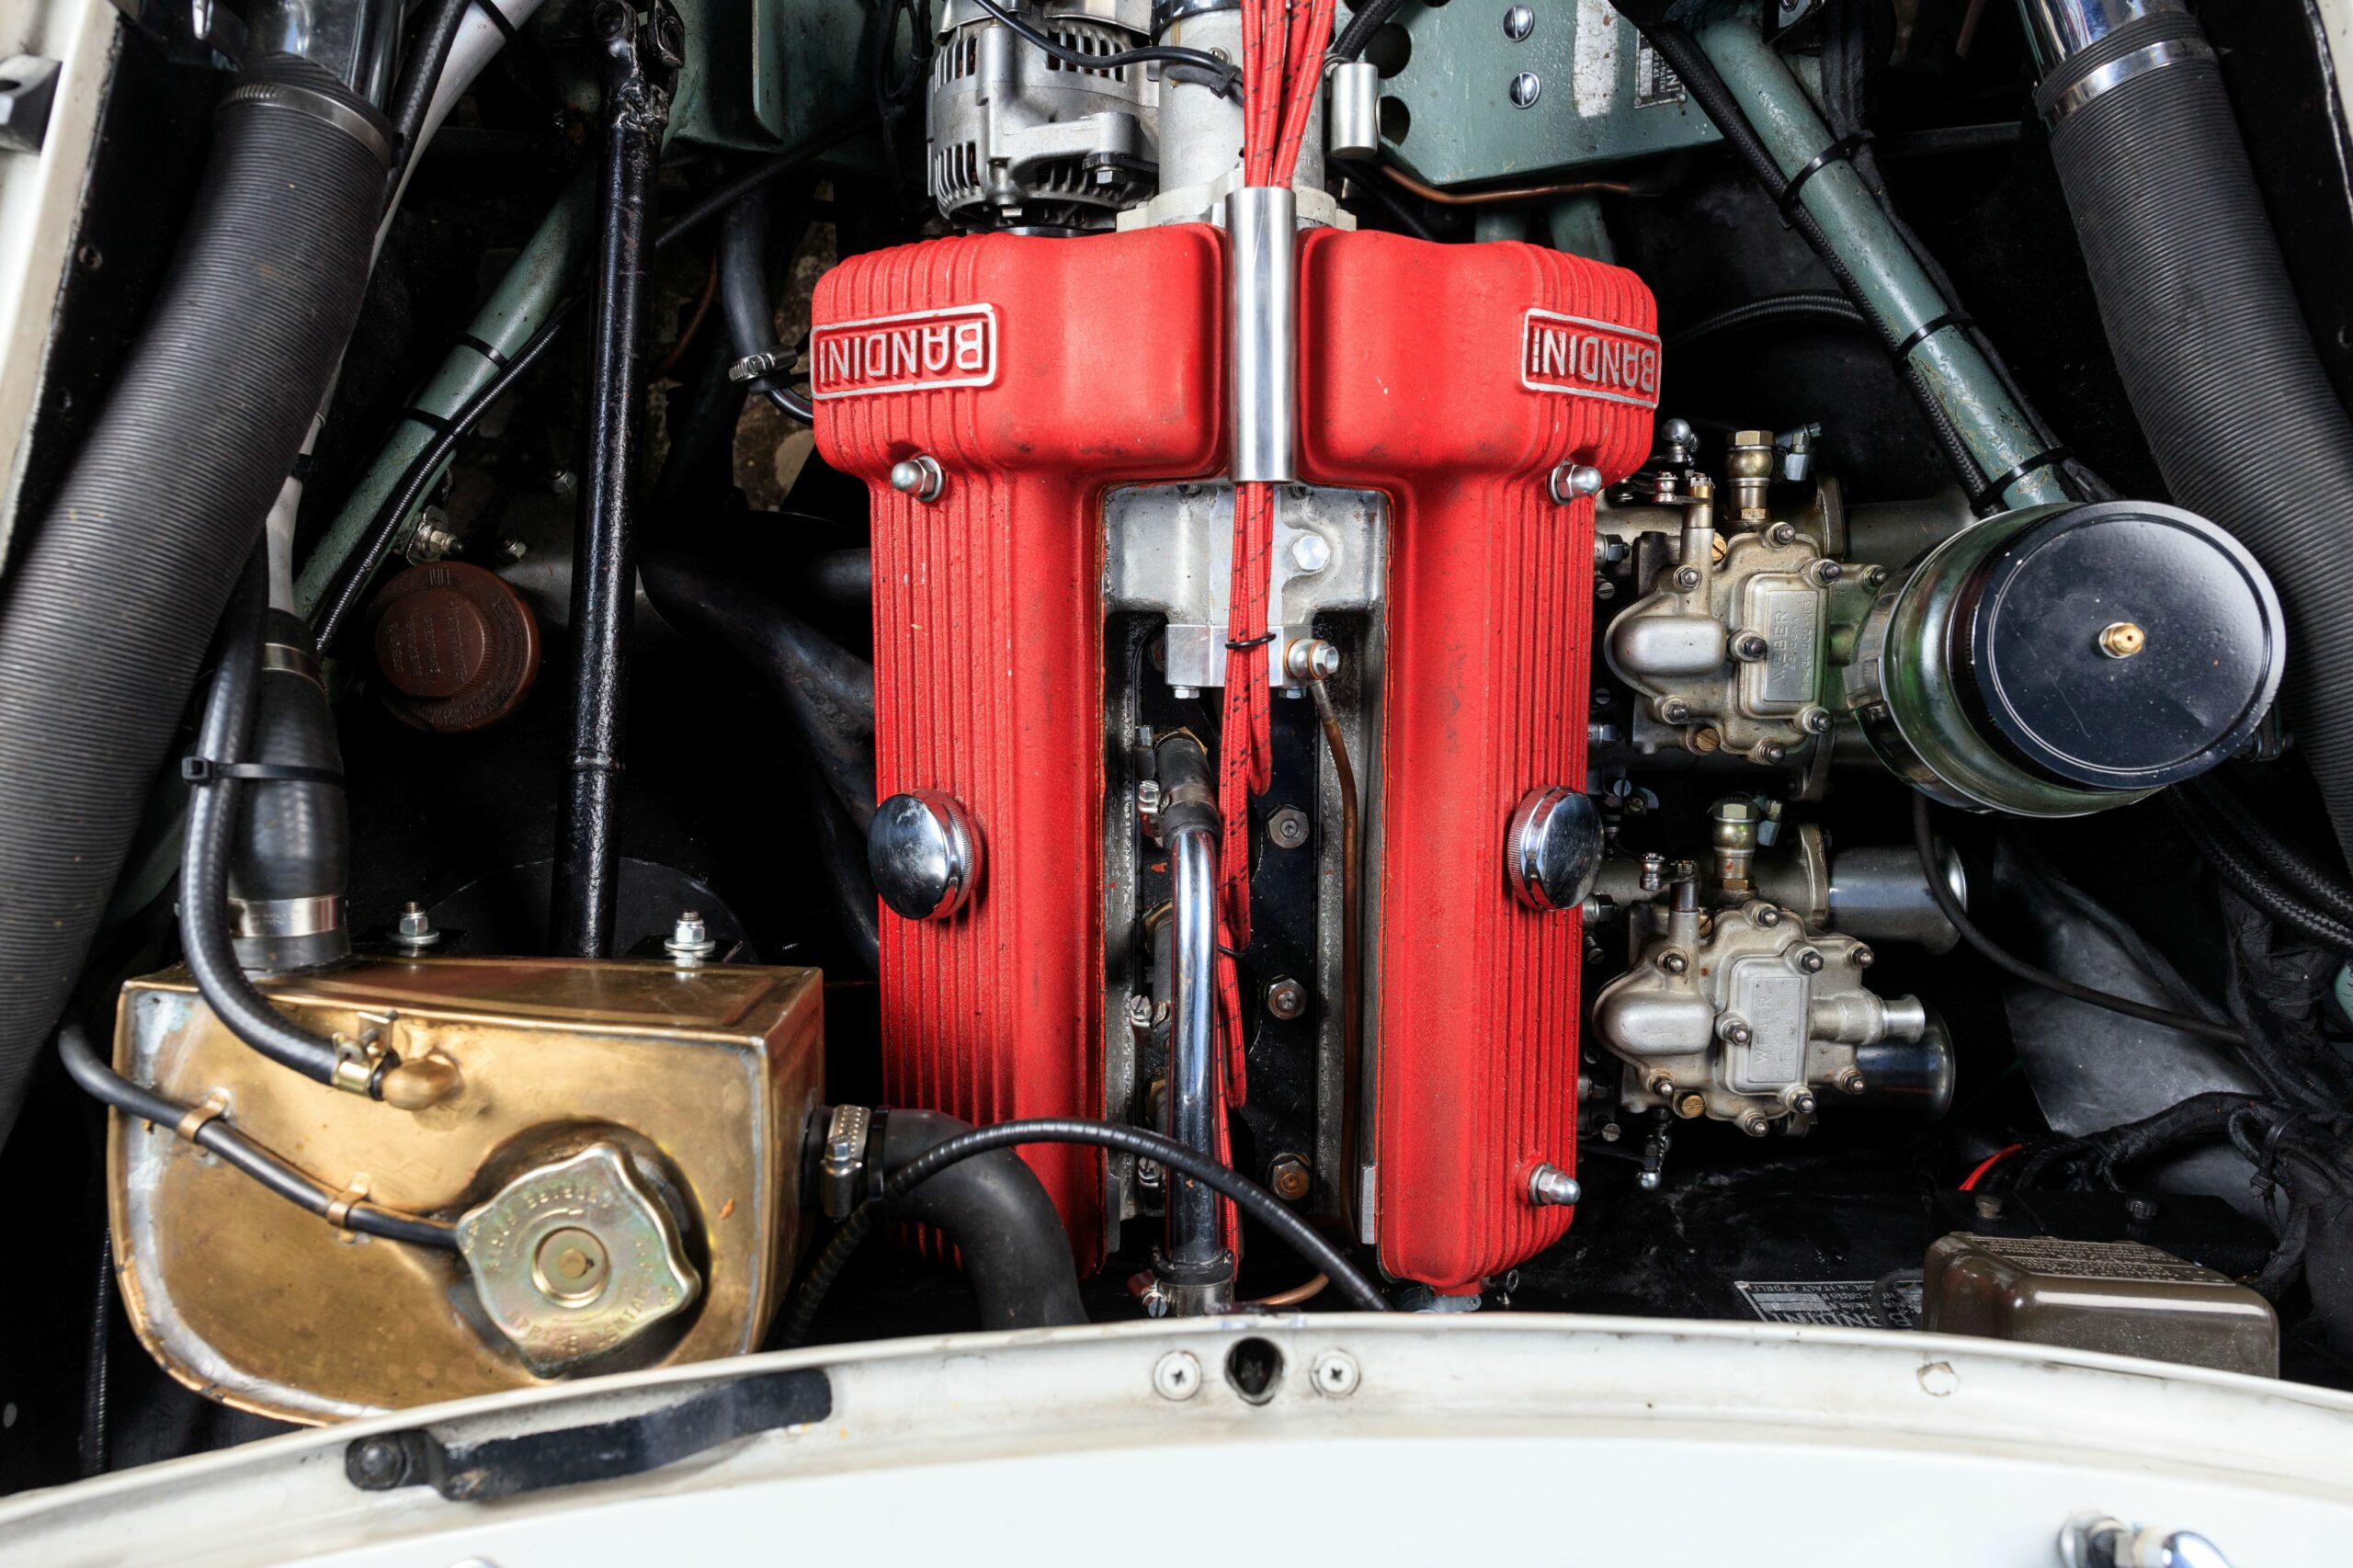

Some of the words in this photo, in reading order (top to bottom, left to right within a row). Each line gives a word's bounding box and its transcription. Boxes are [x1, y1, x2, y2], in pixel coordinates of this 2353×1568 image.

[819, 322, 983, 383] BANDINI
[1531, 327, 1655, 393] BANDINI
[1770, 611, 1789, 683] WEBER
[1755, 997, 1772, 1064] WEBER
